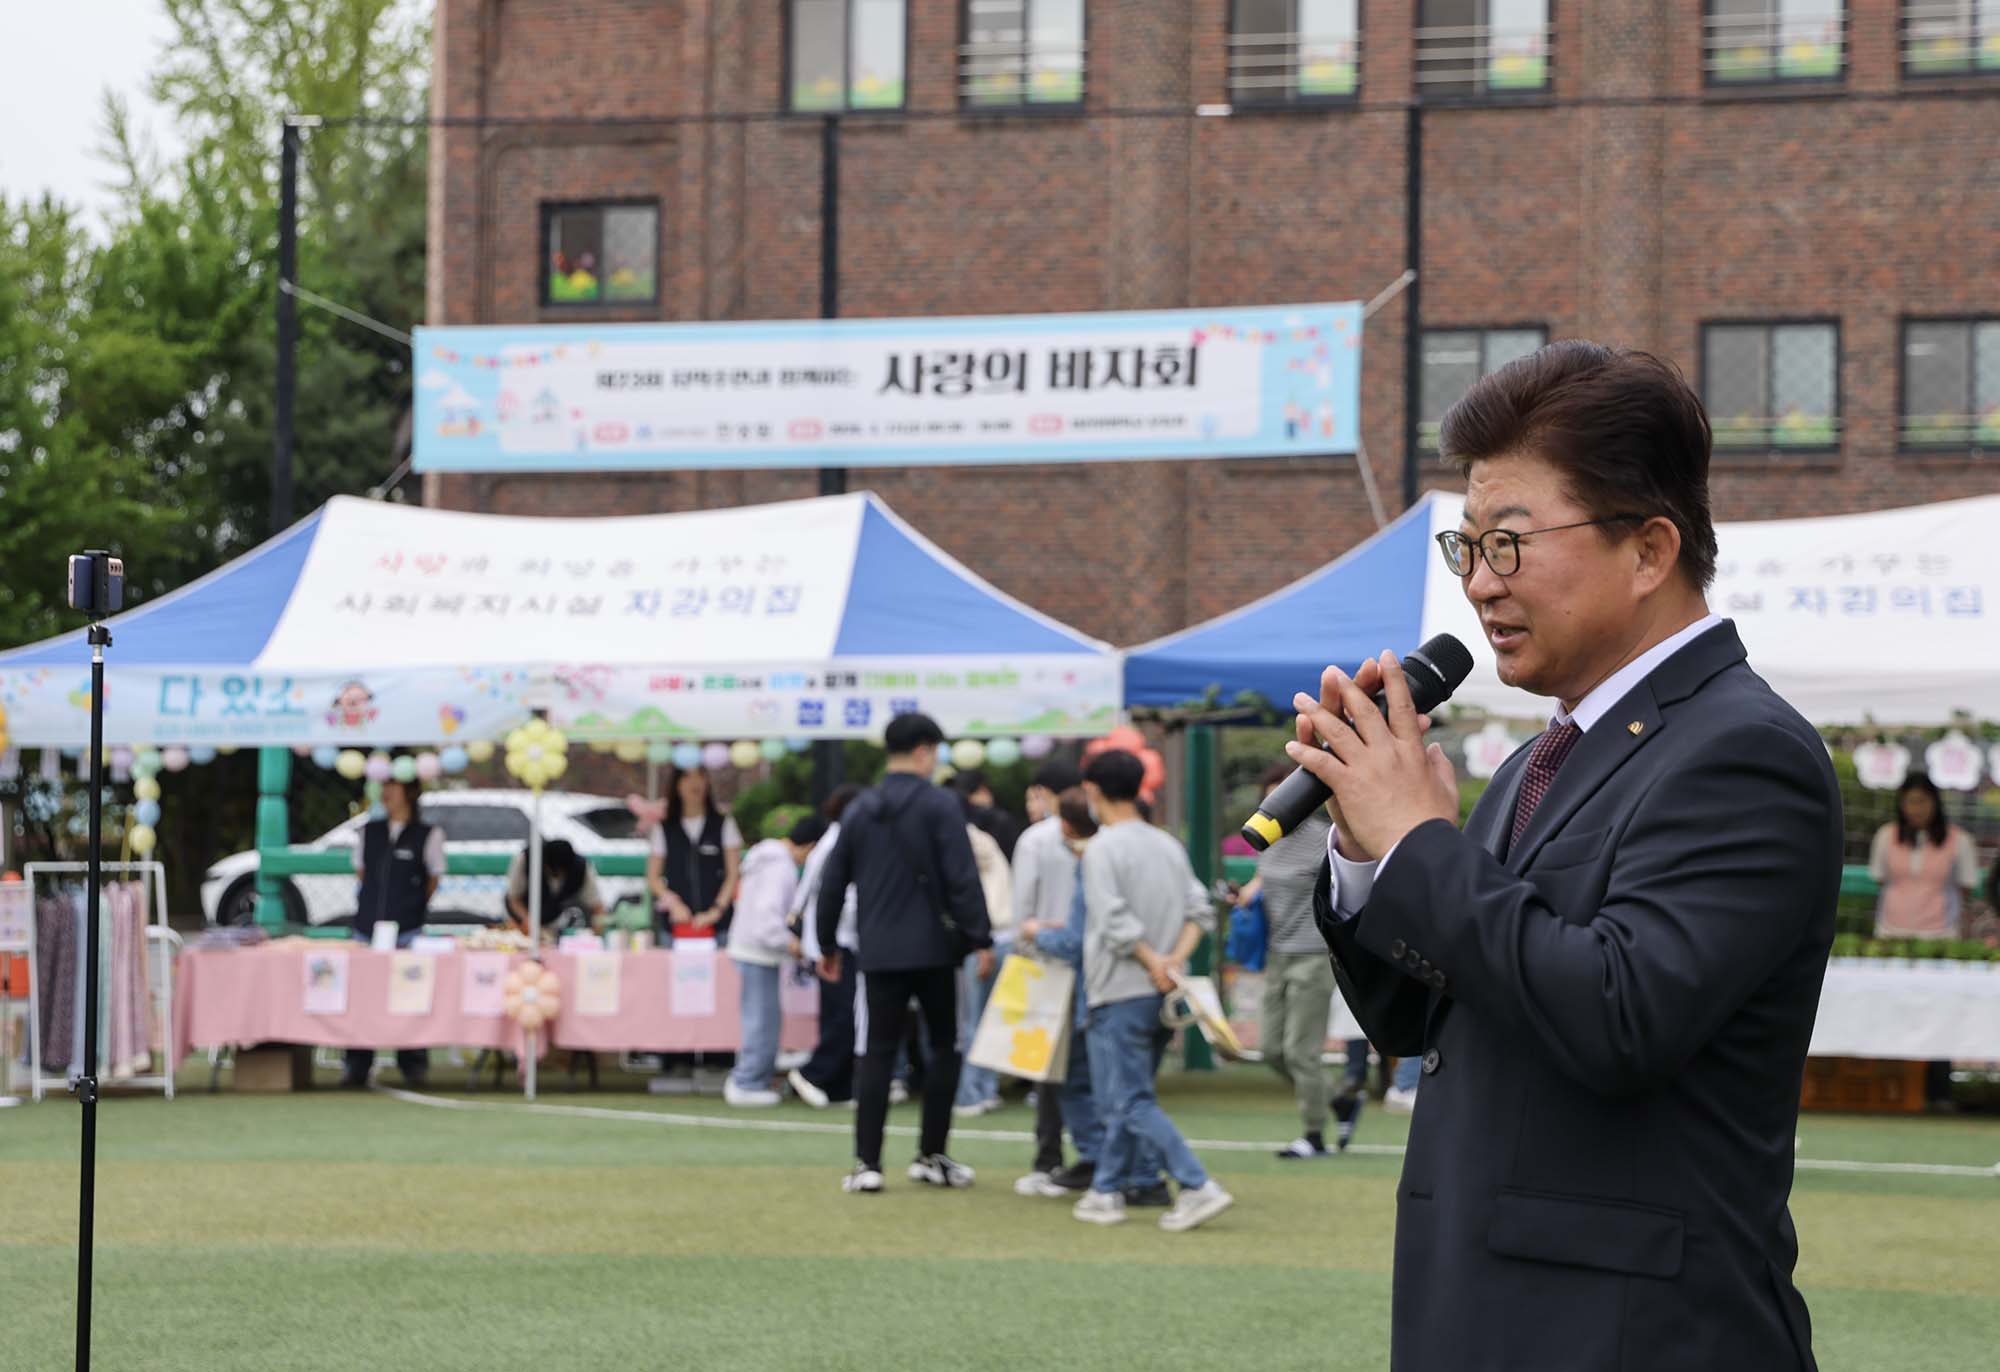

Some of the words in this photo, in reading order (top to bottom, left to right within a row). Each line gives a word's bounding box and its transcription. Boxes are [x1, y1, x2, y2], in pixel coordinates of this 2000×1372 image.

[879, 350, 1030, 397] 사랑의
[1047, 342, 1199, 391] 바자회
[336, 591, 604, 617] 사회복지시설
[158, 673, 204, 718] 다
